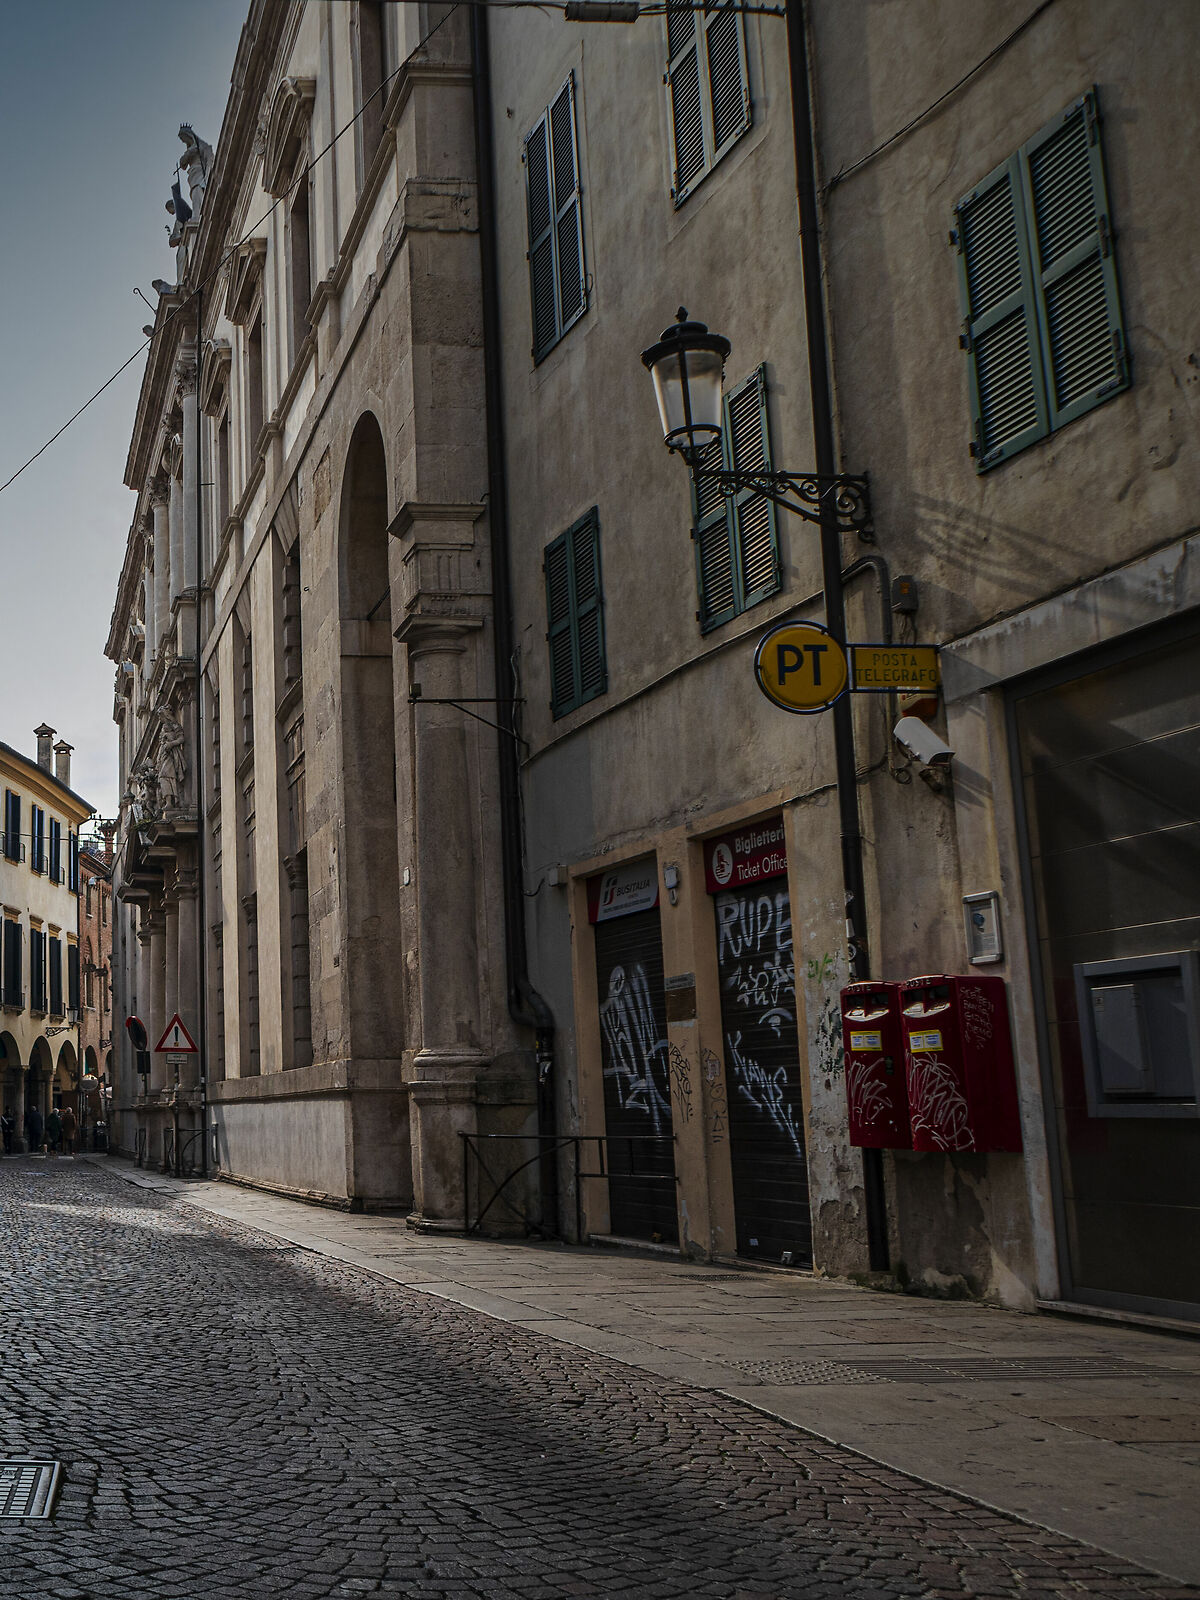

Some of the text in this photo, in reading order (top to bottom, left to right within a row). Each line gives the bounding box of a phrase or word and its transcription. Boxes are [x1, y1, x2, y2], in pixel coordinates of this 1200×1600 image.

[777, 644, 828, 686] PT
[873, 654, 918, 666] POSTA
[856, 669, 937, 682] TELEGRAFO
[737, 853, 788, 880] Ticket Office
